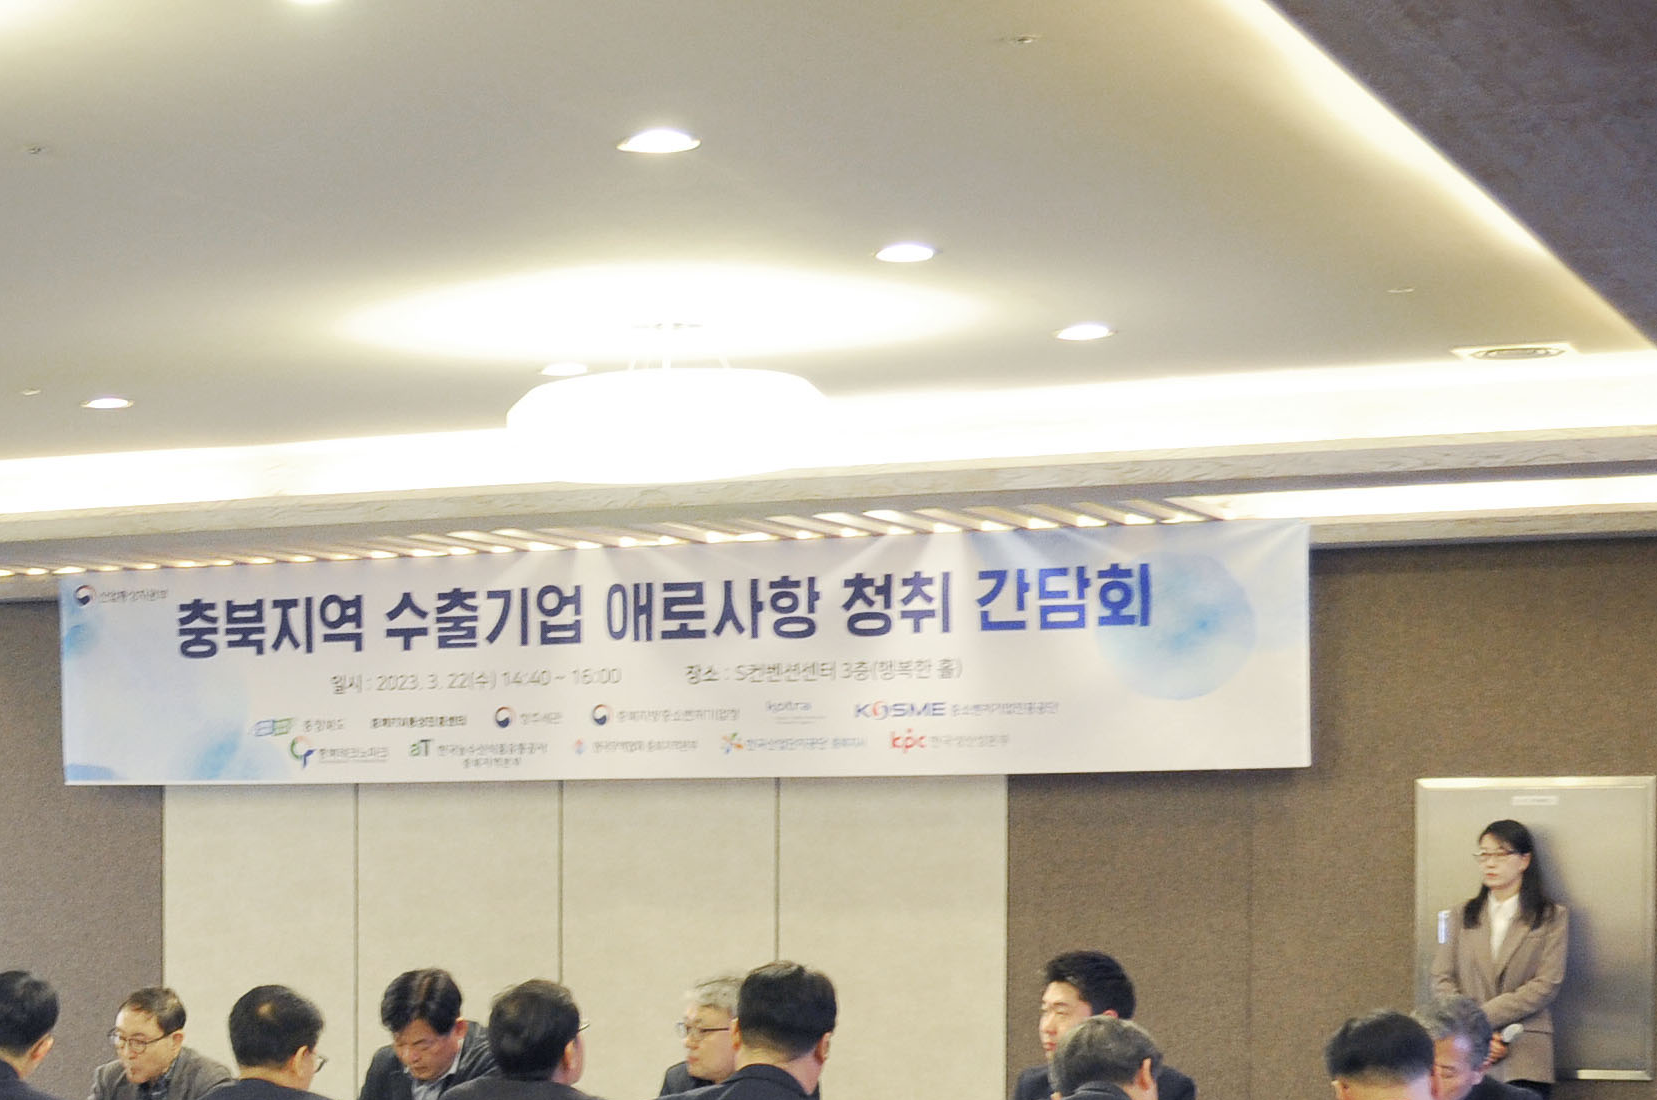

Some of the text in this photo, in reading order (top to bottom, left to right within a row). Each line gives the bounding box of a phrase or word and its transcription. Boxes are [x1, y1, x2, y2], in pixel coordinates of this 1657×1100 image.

[176, 562, 1152, 660] 충북지역 수출기업 애로사항 청취 간담회
[329, 673, 362, 695] 일시
[502, 669, 551, 687] 14:40
[572, 666, 622, 685] 16:00
[684, 663, 720, 685] 장소
[734, 659, 837, 683] S컨벤션센터
[854, 700, 947, 720] KOSME
